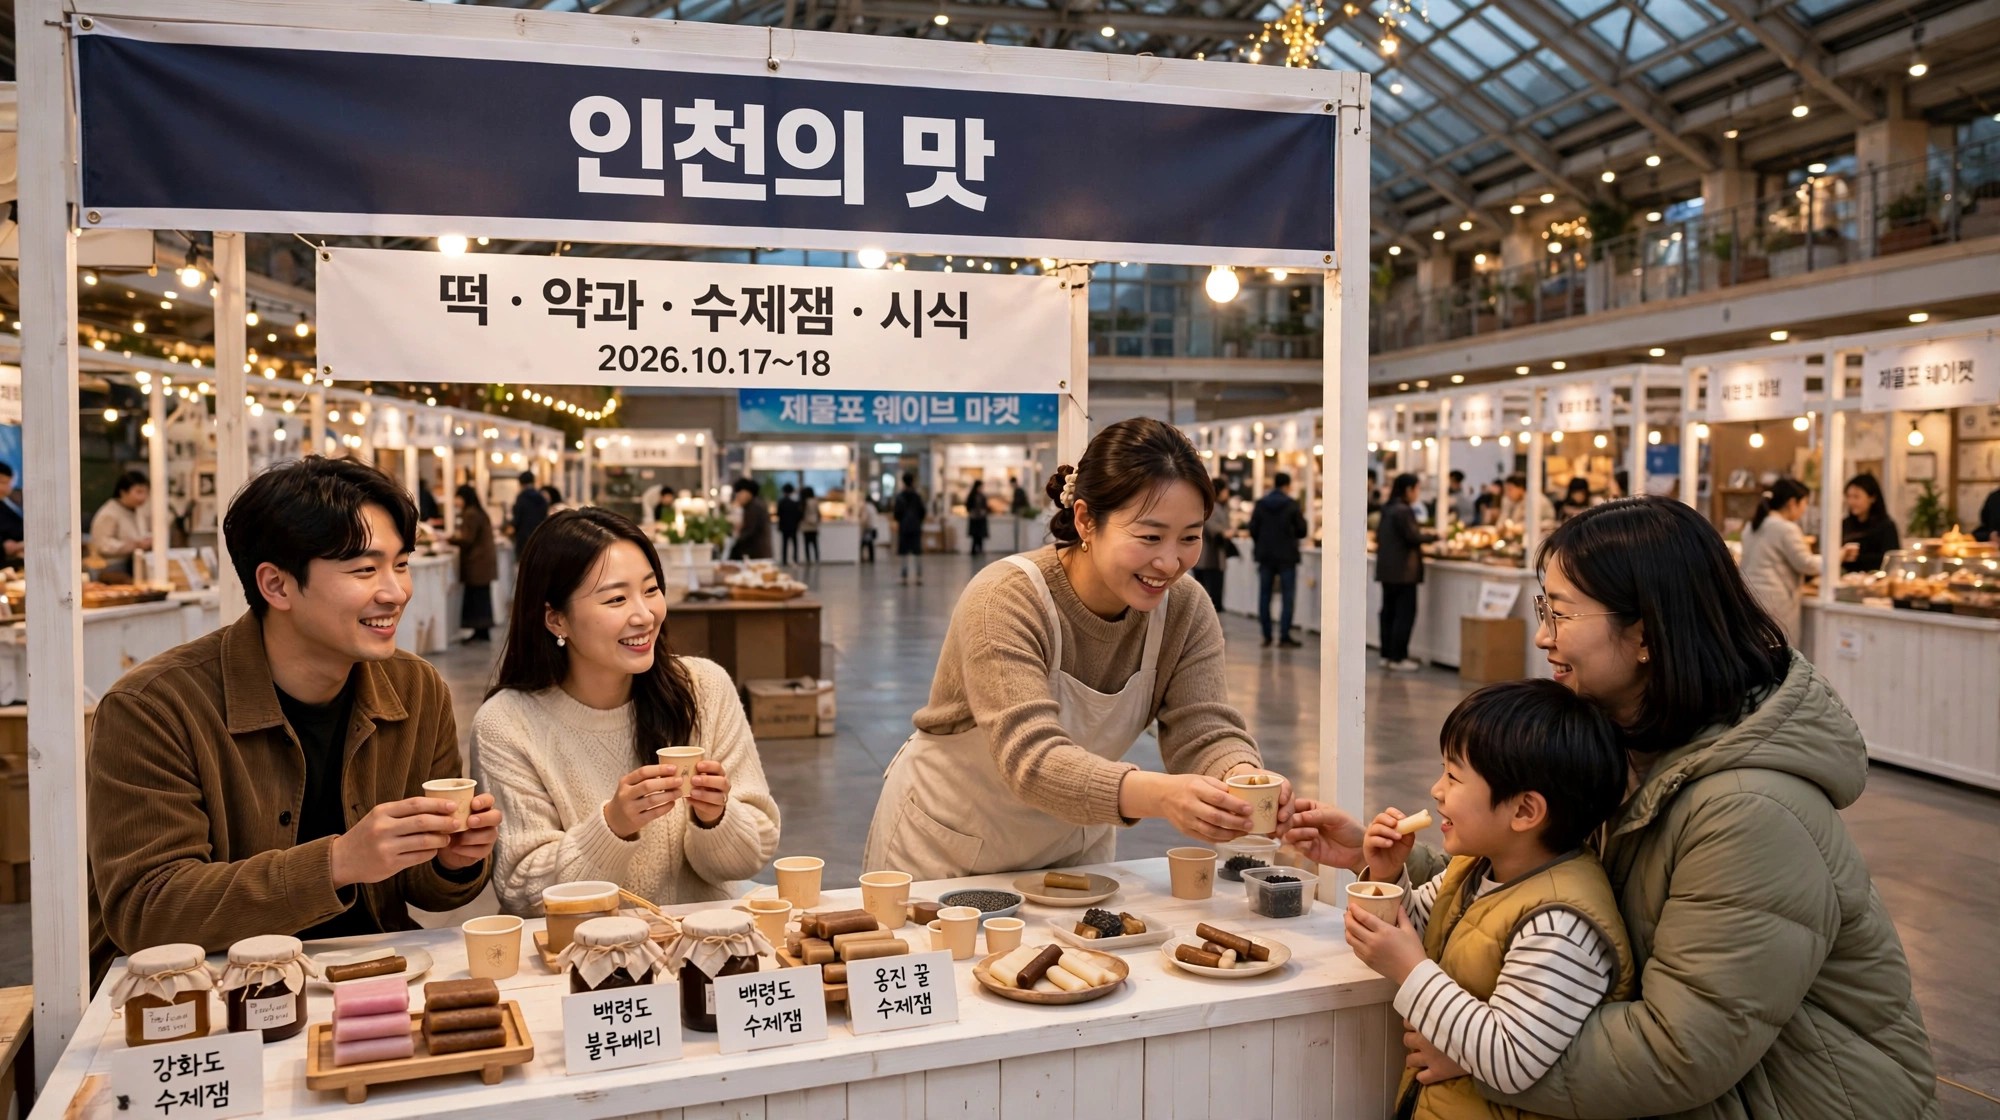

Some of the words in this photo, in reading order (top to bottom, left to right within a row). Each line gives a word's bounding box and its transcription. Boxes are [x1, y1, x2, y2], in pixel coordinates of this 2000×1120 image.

[569, 95, 865, 206] 인천의
[902, 115, 996, 212] 맛
[439, 273, 488, 327] 떡
[542, 277, 645, 331] 약과
[691, 283, 834, 336] 수제잼
[879, 289, 968, 340] 시식
[598, 344, 831, 377] 2026.10.17~18
[779, 394, 866, 425] 제물포
[872, 395, 959, 427] 웨이브
[965, 396, 1020, 426] 마켓
[738, 980, 796, 1008] 백령도
[873, 966, 907, 993] 옹진
[913, 963, 930, 988] 꿀
[593, 998, 652, 1026] 백령도
[876, 991, 932, 1020] 수제잼
[743, 1008, 802, 1038] 수제잼
[584, 1026, 661, 1061] 불루베리
[152, 1050, 225, 1083] 강화도
[154, 1080, 230, 1116] 수제잼
